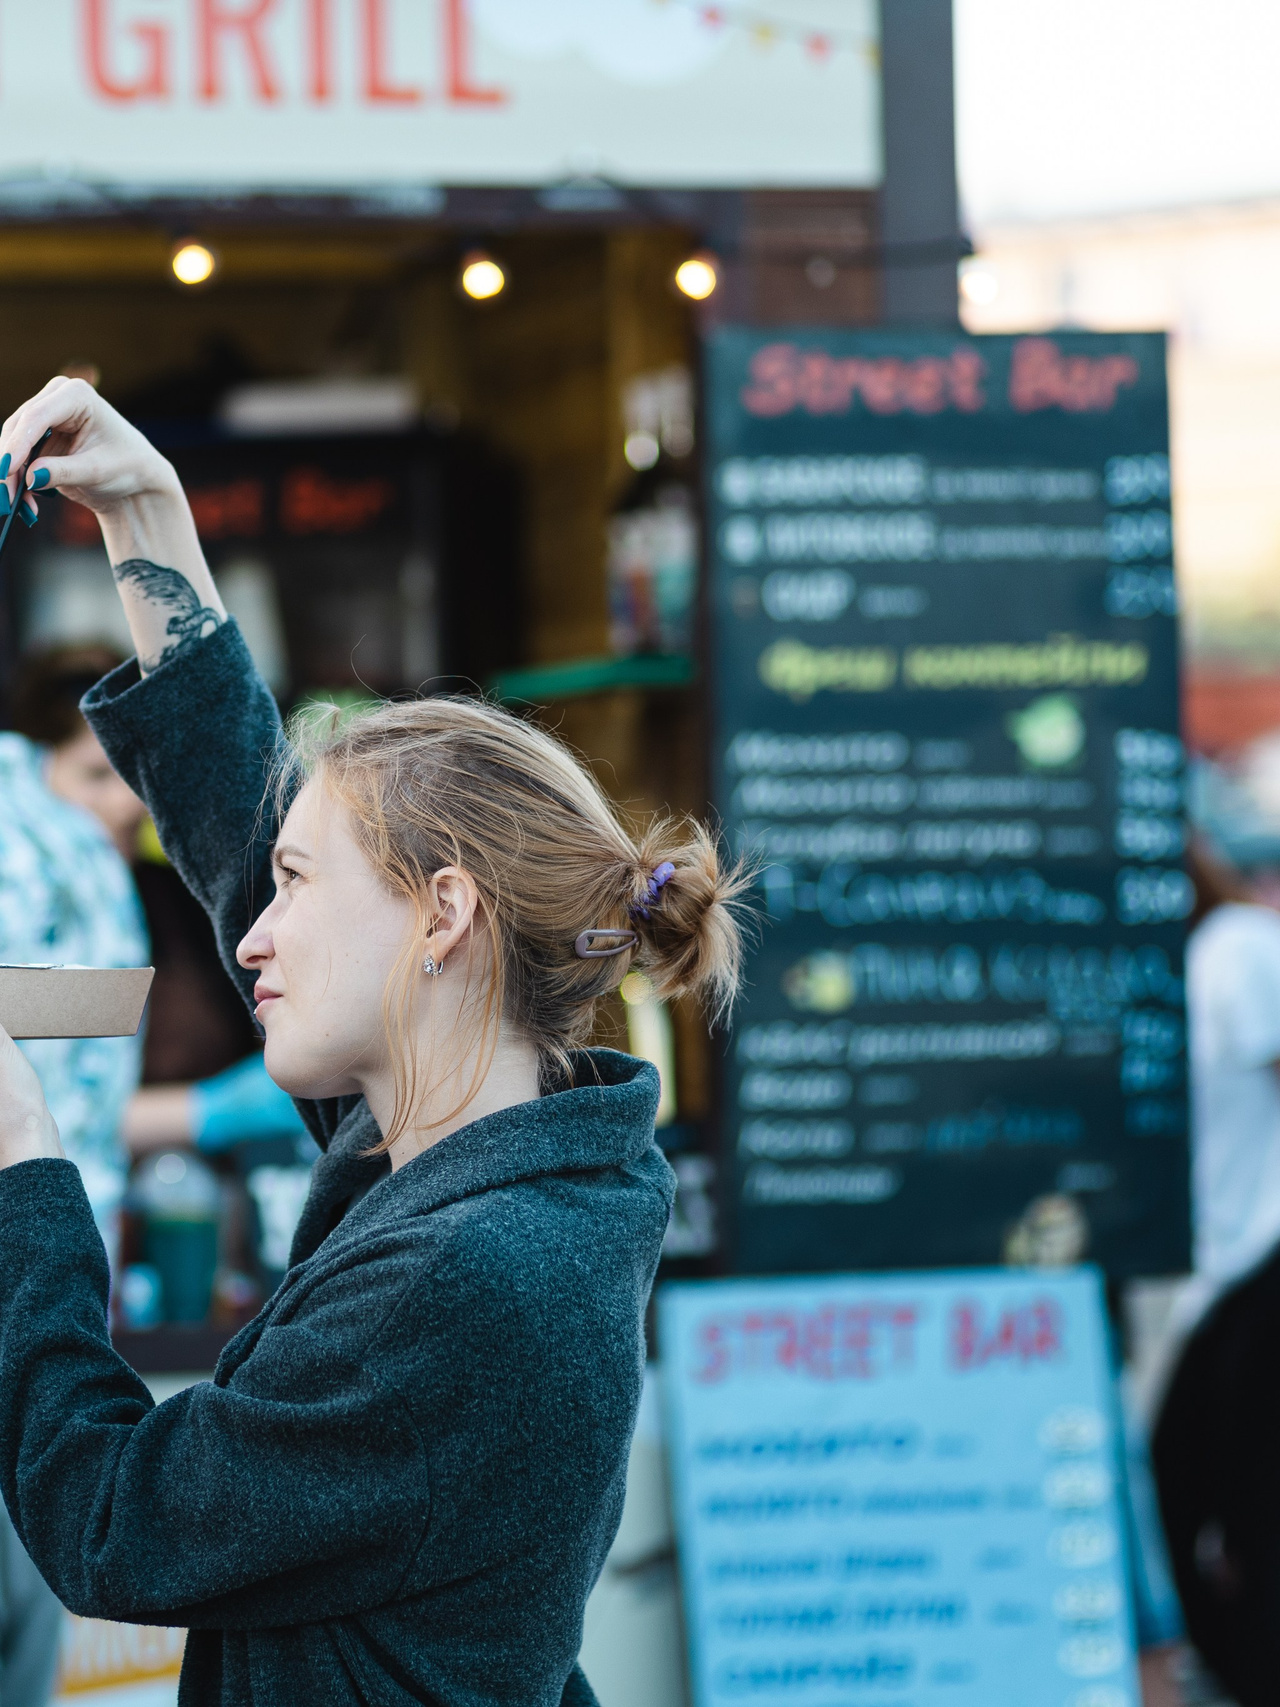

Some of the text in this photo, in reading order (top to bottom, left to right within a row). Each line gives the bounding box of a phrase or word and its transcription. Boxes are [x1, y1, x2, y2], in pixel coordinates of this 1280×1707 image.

[82, 0, 511, 105] GRILL
[742, 336, 1138, 417] Street Bar
[692, 1294, 1071, 1383] STREET BAR
